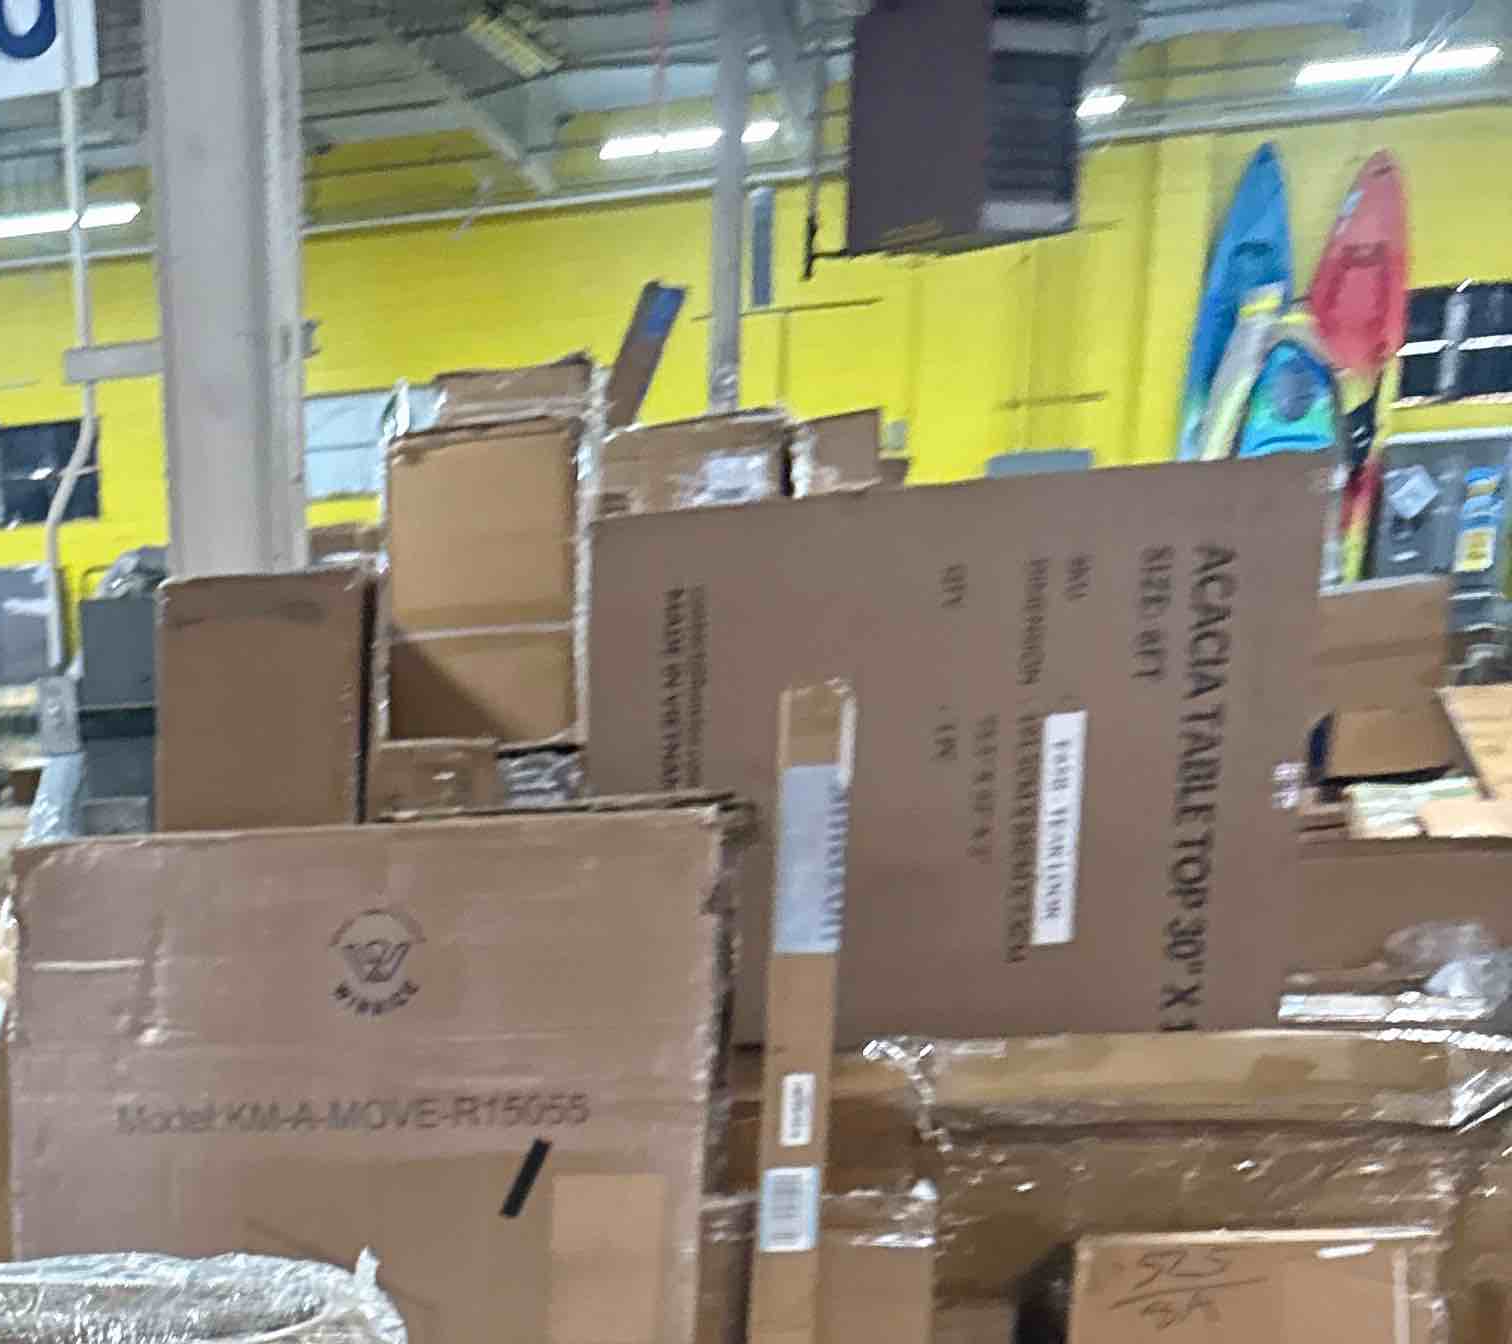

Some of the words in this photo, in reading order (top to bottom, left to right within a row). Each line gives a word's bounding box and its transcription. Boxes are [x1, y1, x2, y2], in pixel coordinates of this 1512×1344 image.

[1186, 545, 1237, 699] ACACIA
[1177, 703, 1227, 824] TABLE
[1168, 831, 1213, 910] TOP
